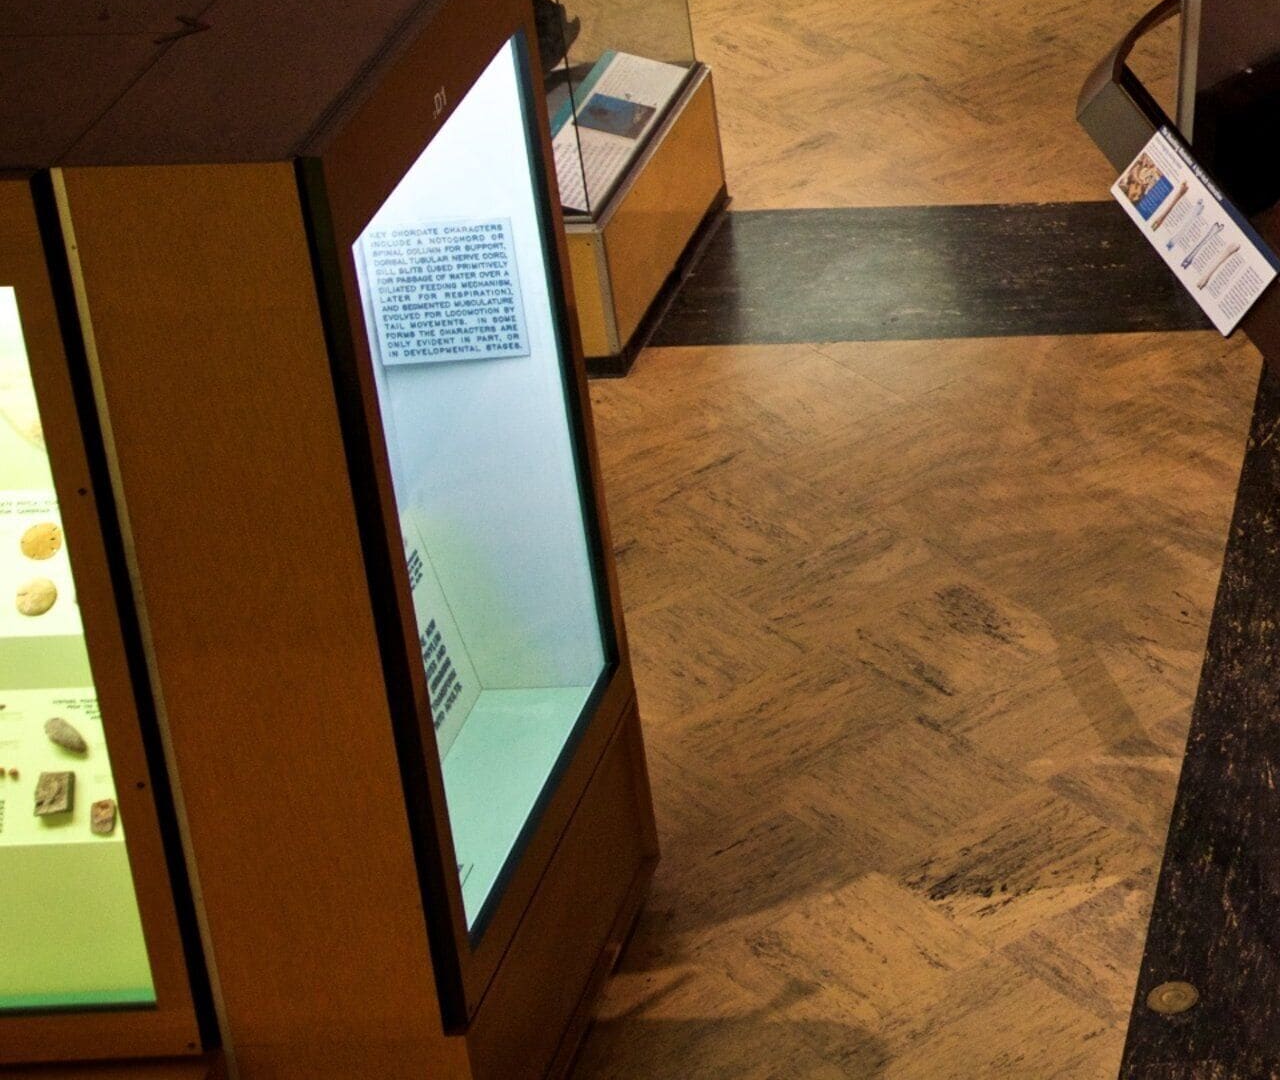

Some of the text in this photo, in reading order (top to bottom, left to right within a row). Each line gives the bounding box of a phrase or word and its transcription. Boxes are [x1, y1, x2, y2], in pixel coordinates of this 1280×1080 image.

[391, 227, 438, 236] CHORDATE
[443, 224, 502, 233] CHARACTERS
[370, 238, 410, 247] INCLUDE
[416, 237, 422, 245] A
[428, 234, 485, 244] NOTOCHORD
[406, 246, 441, 255] COLUMN
[444, 245, 461, 253] FOR
[464, 242, 505, 251] SUPPORT,
[373, 257, 408, 266] DORSAL
[409, 255, 448, 264] TUBULAR
[451, 253, 479, 261] NERVE
[375, 260, 508, 276] GILL SLITS (USED PRIMITIVELY
[396, 274, 433, 283] PASSAGE
[449, 272, 476, 280] WATER
[479, 270, 500, 278] OVER
[378, 279, 511, 294] CILIATED FEEDING MECHANISM,
[380, 294, 410, 303] LATER
[418, 292, 437, 300] FOR
[381, 297, 513, 312] AND SEGMENTED MUSCULATURE
[383, 312, 420, 321] EVOLVED
[444, 307, 499, 317] LOCOMOTION
[410, 318, 467, 329] MOVEMENTS.
[492, 315, 516, 323] SOME
[386, 323, 517, 339] FORMS THE CHARACTERS ARE
[387, 340, 410, 348] ONLY
[416, 337, 455, 346] EVIDENT
[476, 334, 501, 342] PART,
[506, 332, 519, 340] OR
[388, 341, 522, 358] IN DEVELOPMENTAL STAGES.
